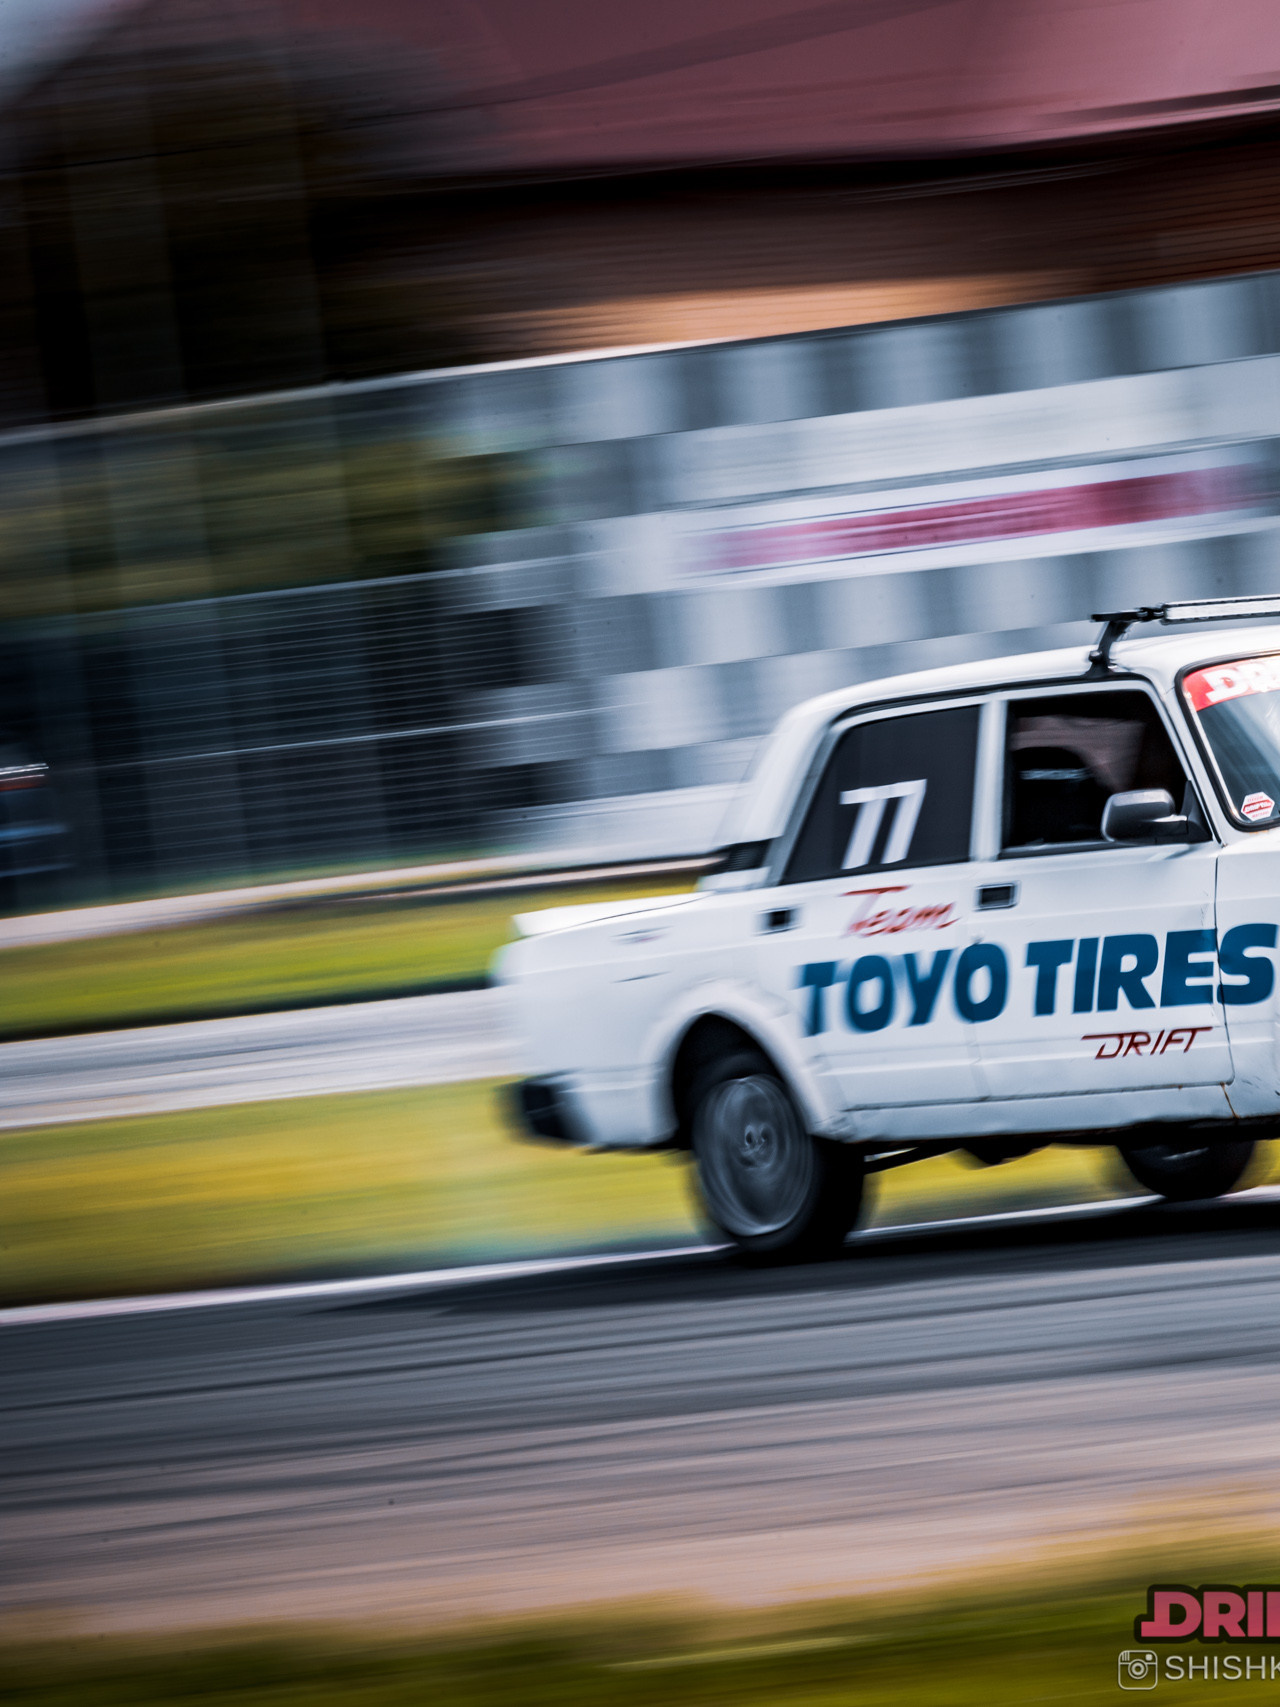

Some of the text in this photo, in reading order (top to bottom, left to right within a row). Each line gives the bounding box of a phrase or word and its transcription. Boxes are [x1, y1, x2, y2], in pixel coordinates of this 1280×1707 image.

[840, 778, 927, 870] 77
[841, 886, 959, 938] Team
[797, 922, 1279, 1037] TOYO TIRES
[1081, 1026, 1213, 1060] DRIFT
